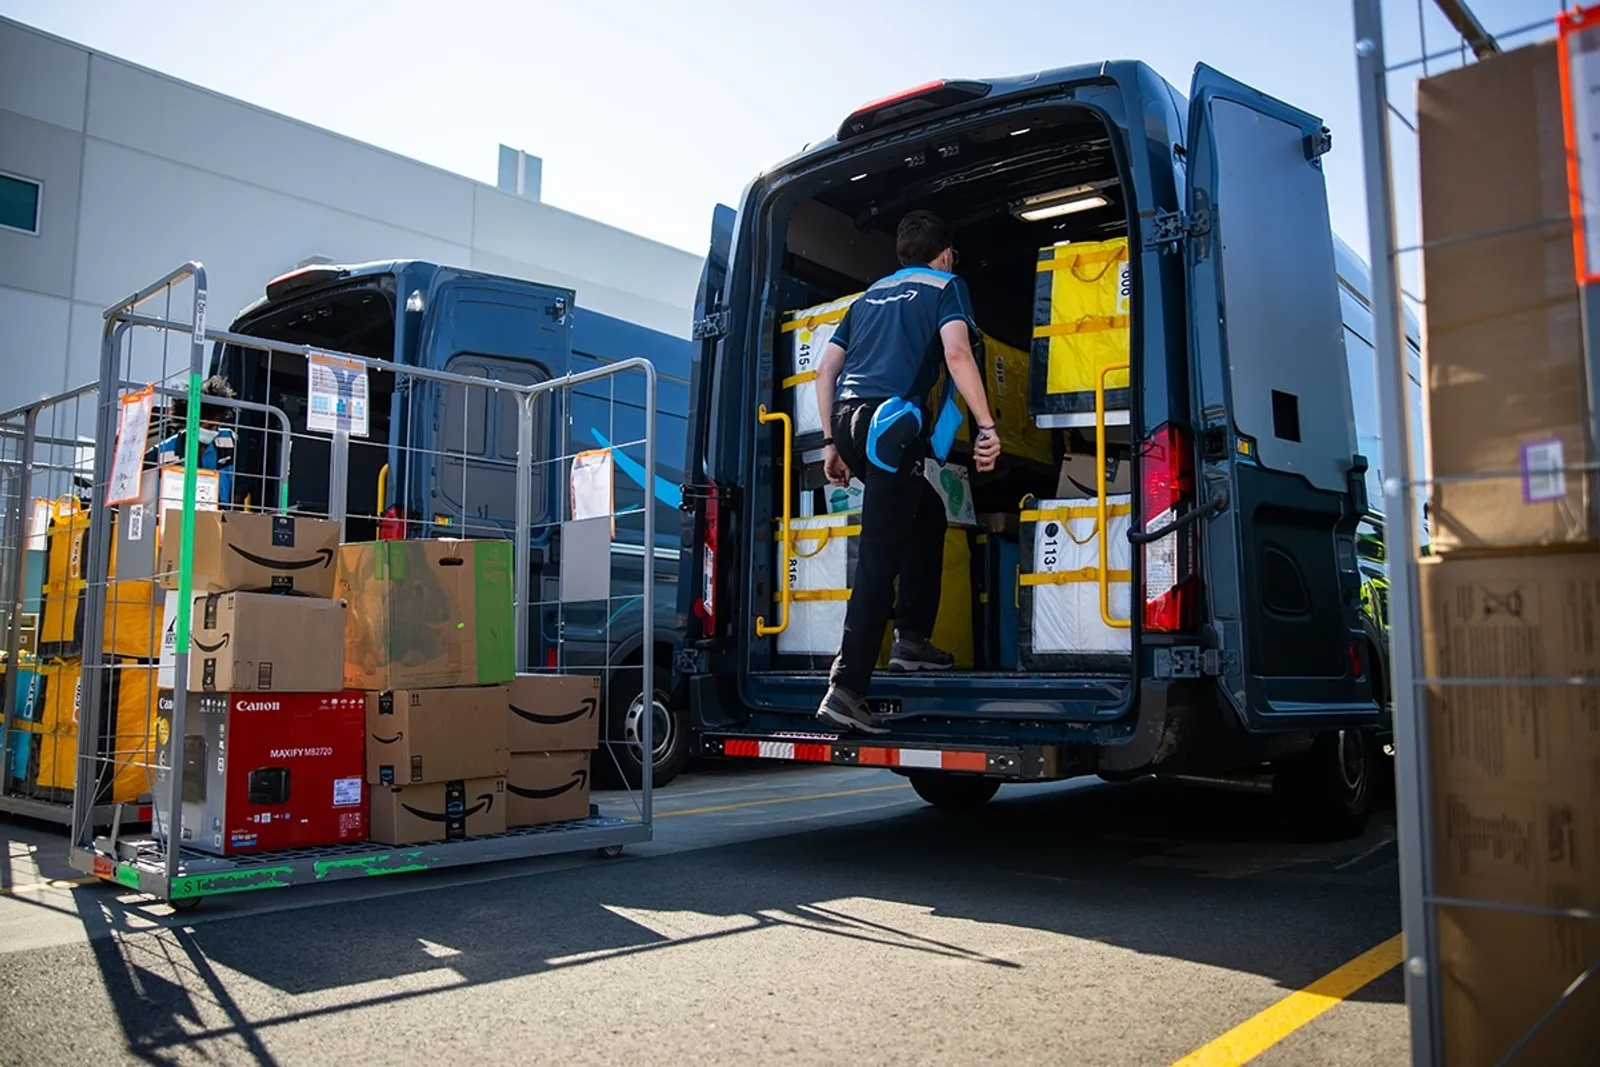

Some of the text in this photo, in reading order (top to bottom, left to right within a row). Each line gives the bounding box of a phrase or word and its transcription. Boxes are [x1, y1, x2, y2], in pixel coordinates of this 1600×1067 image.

[799, 344, 811, 366] 415
[1044, 539, 1059, 566] 113
[159, 698, 174, 710] Can
[236, 700, 280, 712] Canon
[269, 746, 333, 759] MAXIFY MB2720
